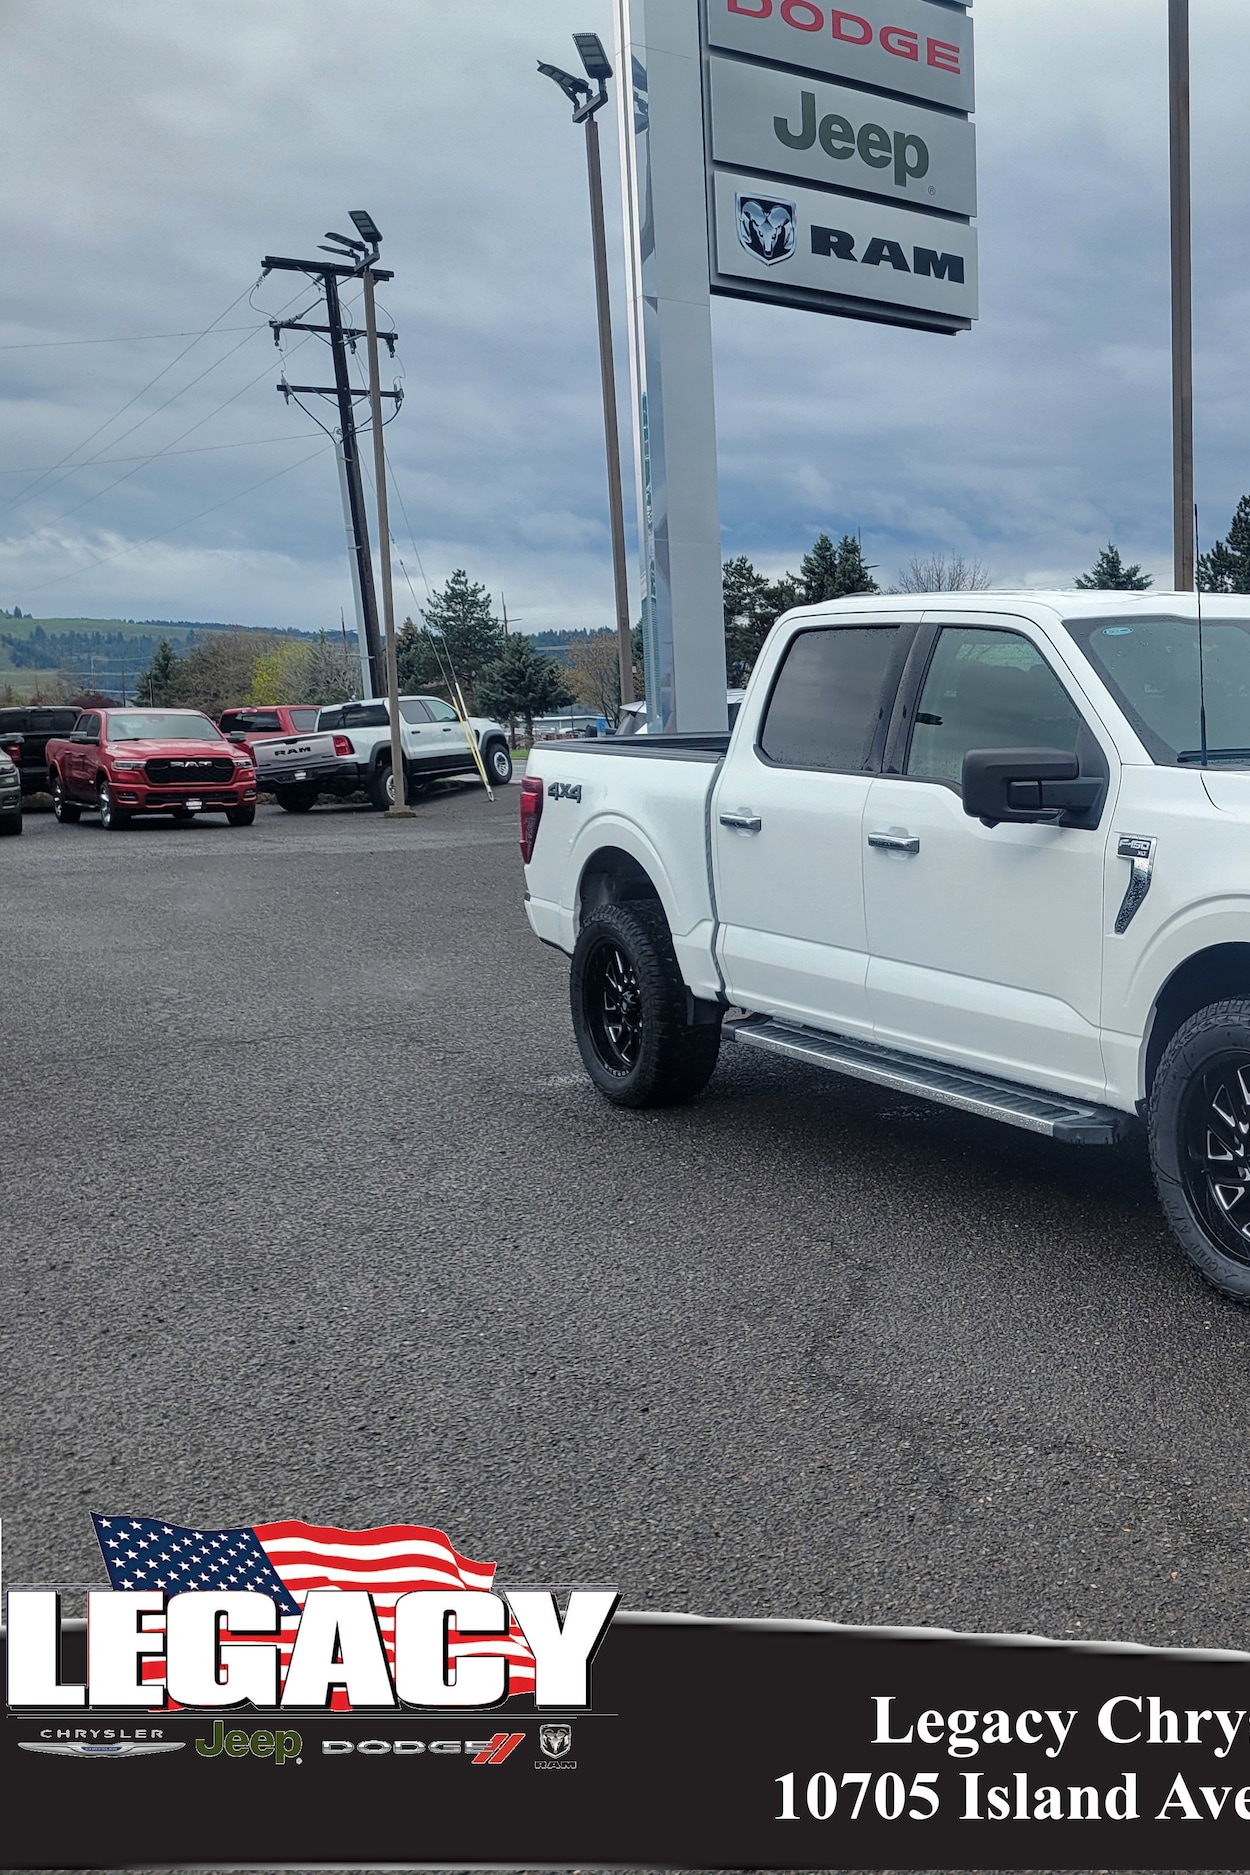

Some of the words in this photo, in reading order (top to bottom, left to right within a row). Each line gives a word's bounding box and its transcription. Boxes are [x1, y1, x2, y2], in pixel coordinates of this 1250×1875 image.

[773, 91, 929, 187] Jeep
[810, 225, 964, 284] RAM
[274, 747, 312, 756] RAM
